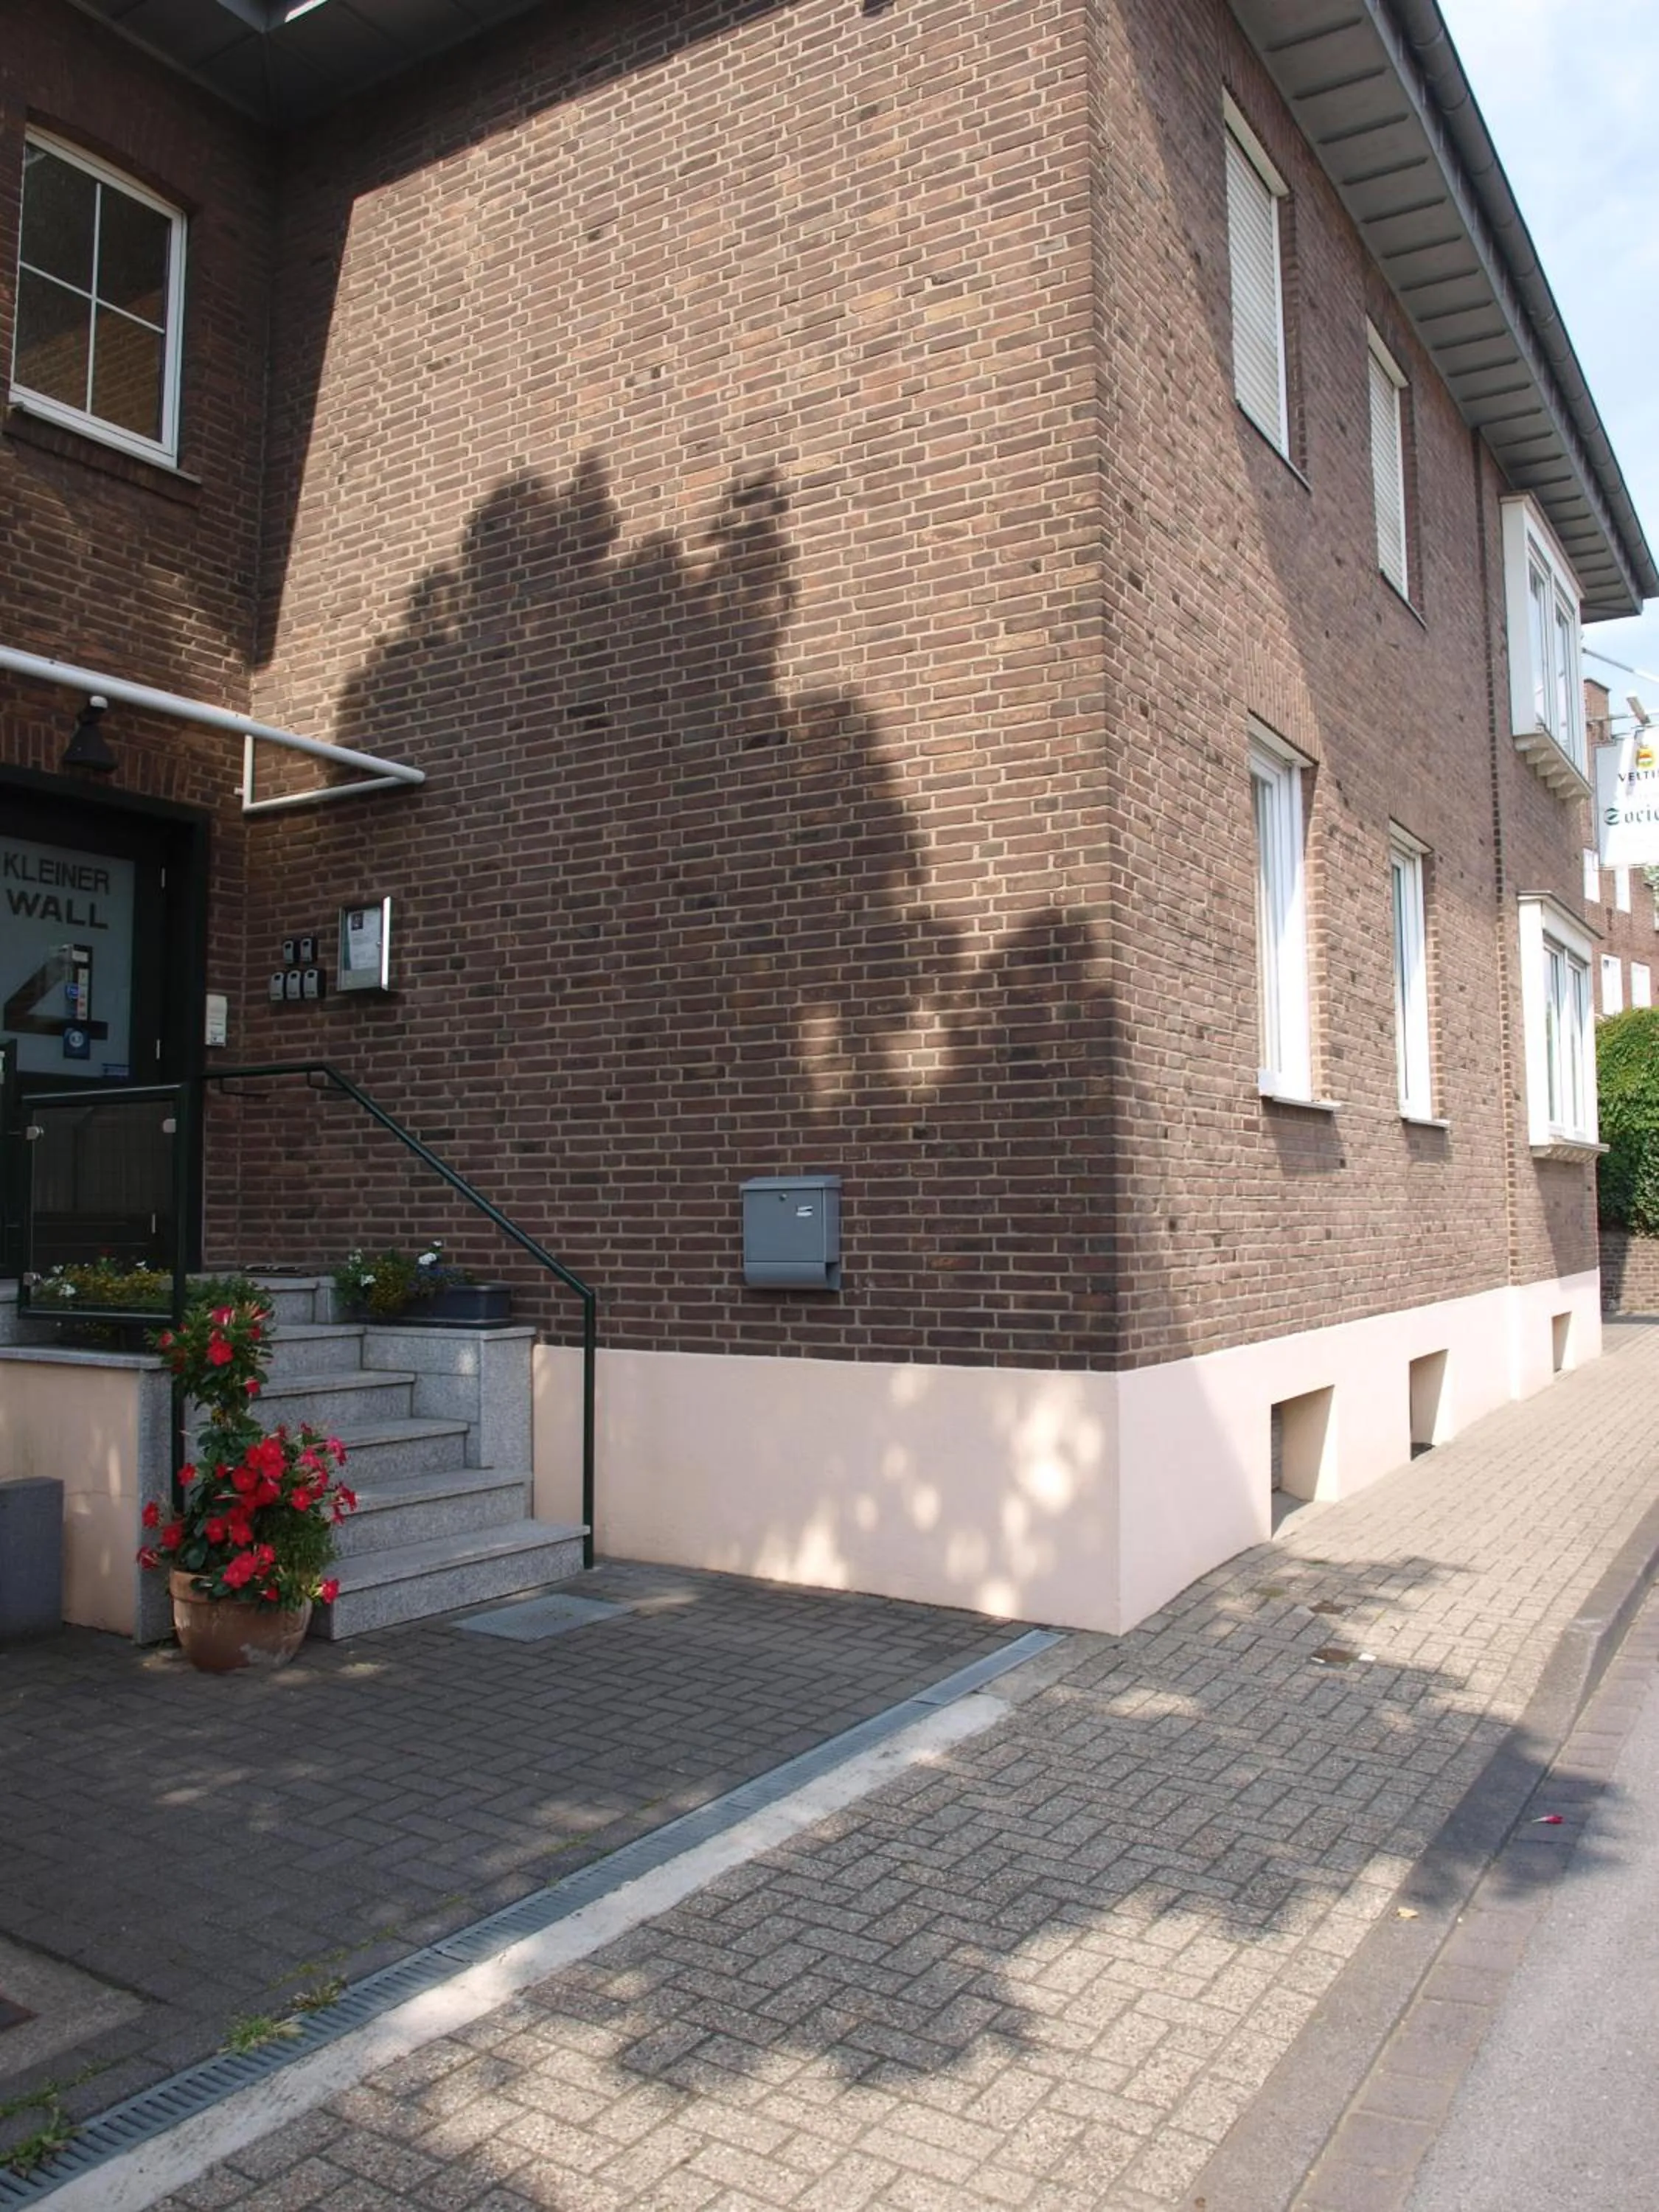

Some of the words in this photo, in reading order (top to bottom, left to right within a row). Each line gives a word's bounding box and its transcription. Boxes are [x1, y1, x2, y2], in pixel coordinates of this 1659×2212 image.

[1617, 768, 1659, 782] VELTI
[4, 851, 109, 895] KLEINER
[7, 888, 109, 930] WALL
